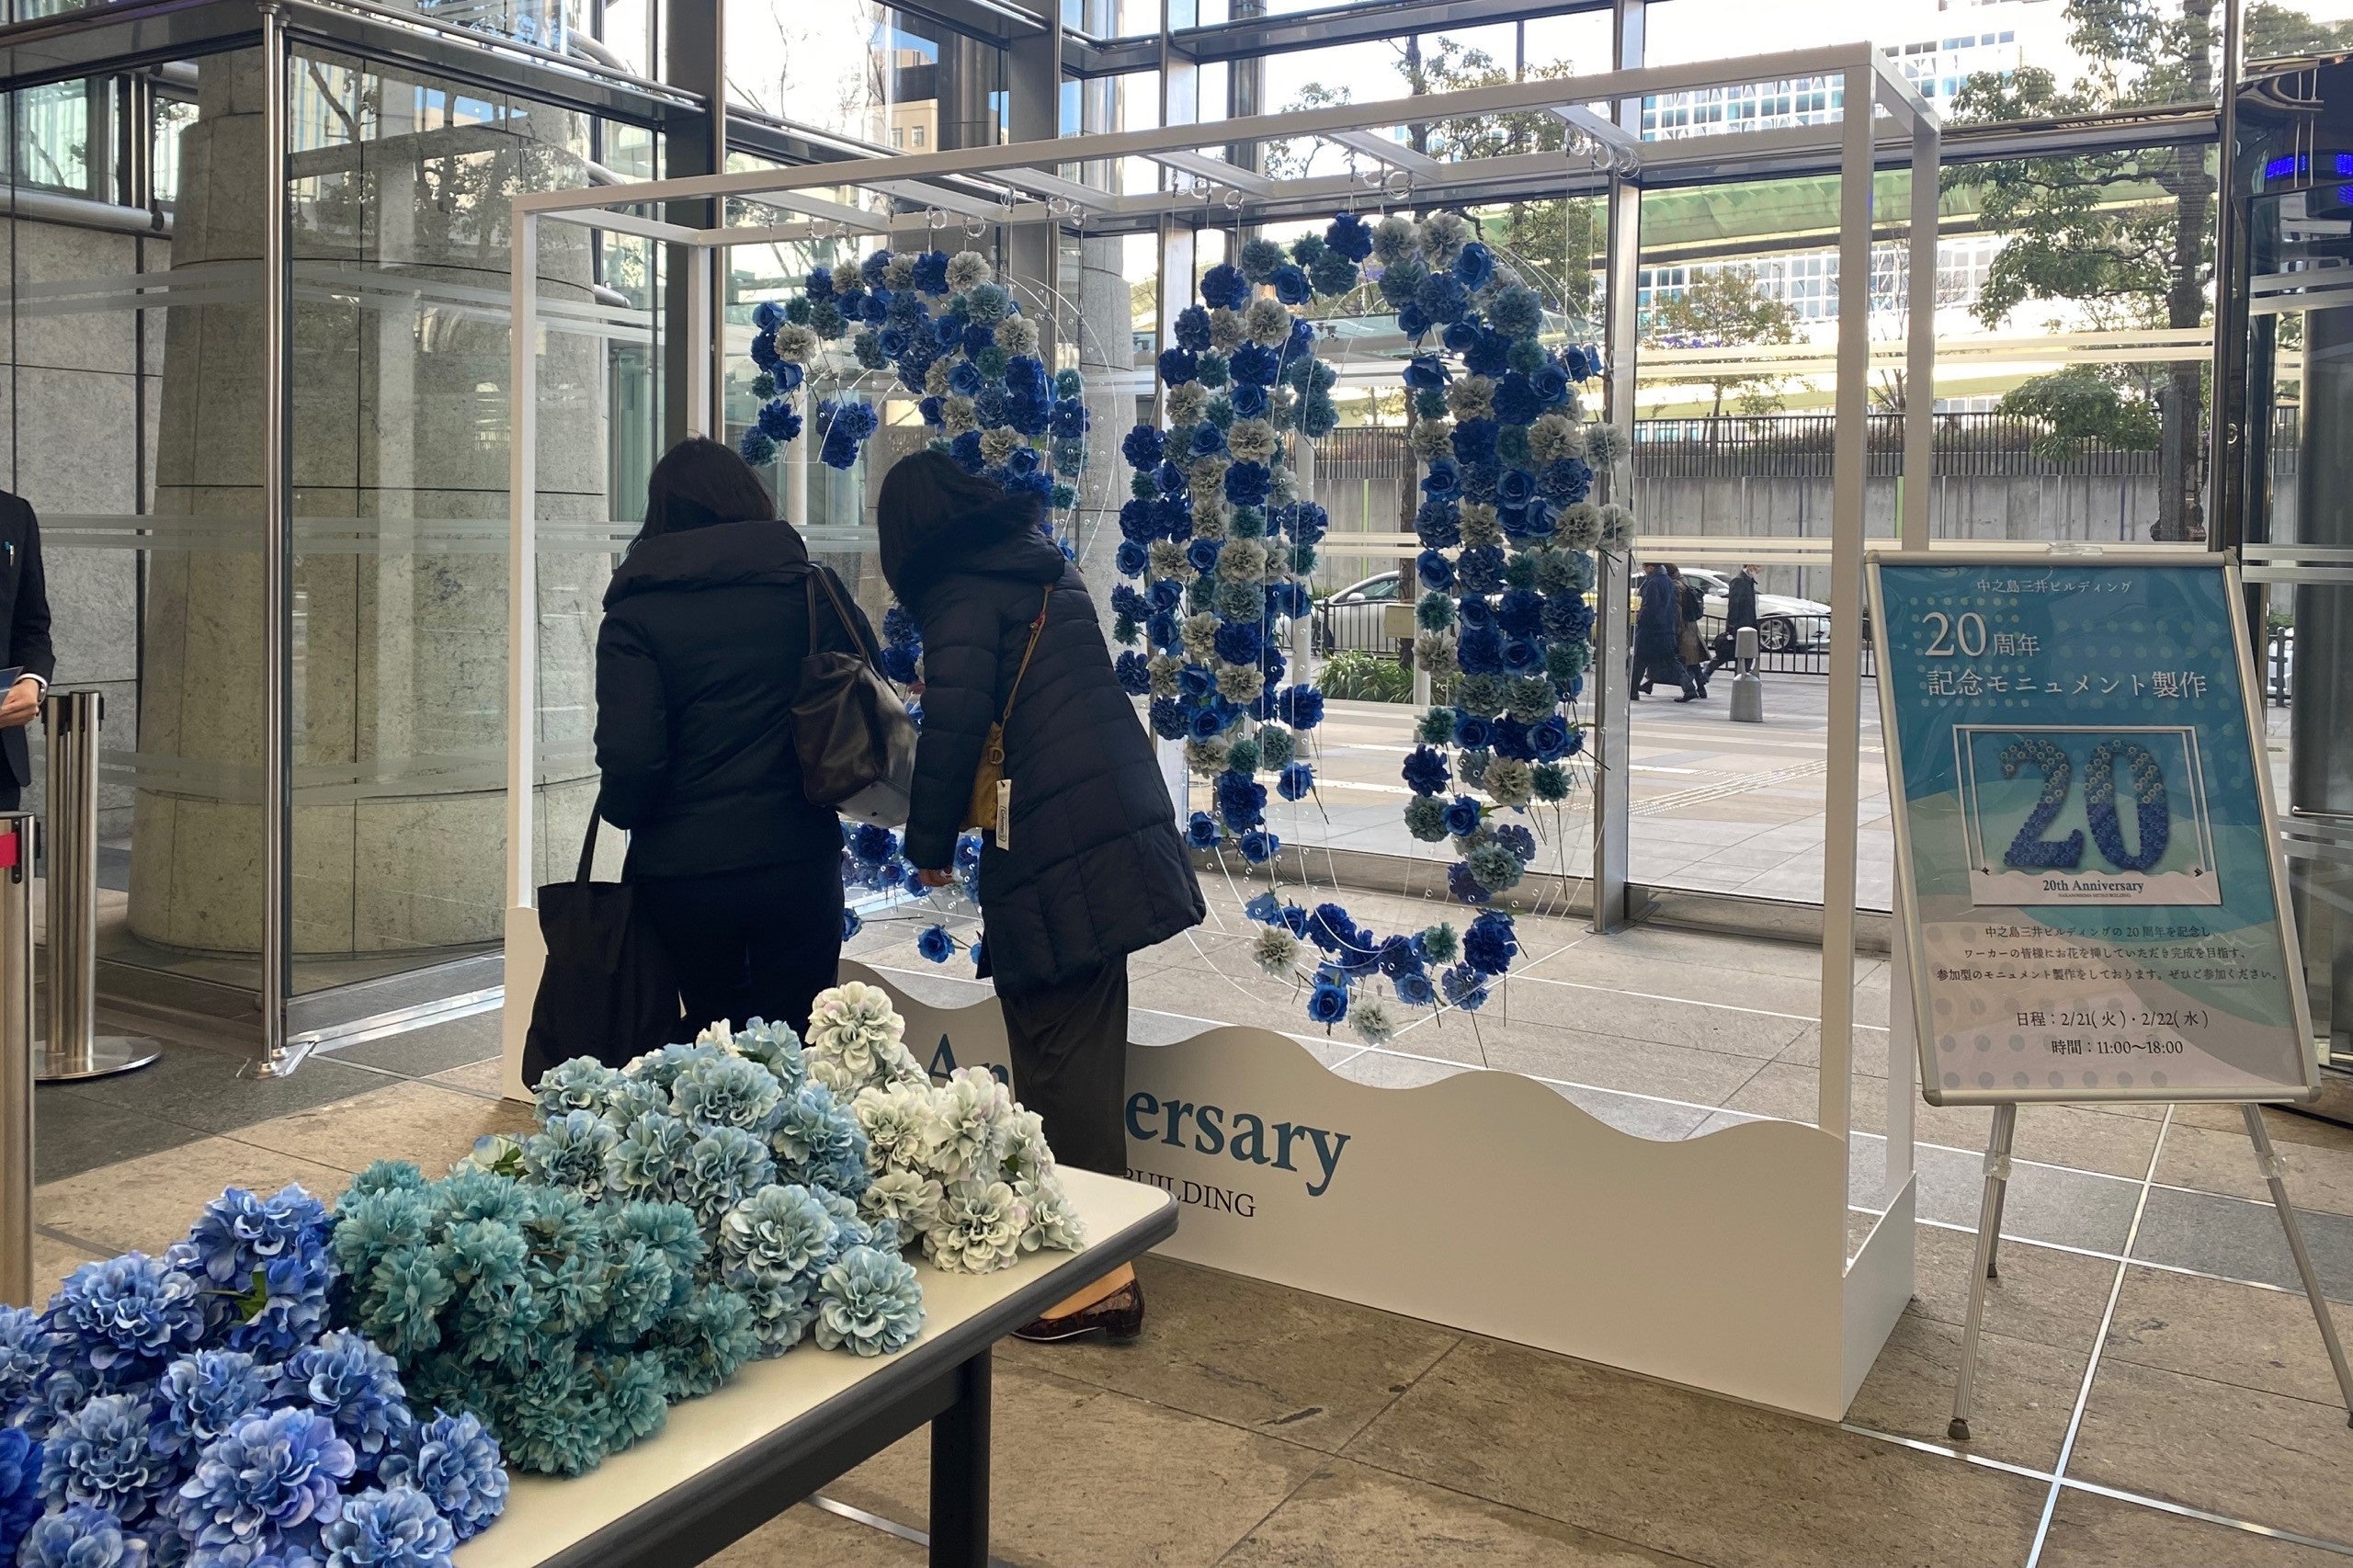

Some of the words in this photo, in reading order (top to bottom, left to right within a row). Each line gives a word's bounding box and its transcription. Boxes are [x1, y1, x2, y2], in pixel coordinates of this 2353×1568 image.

[1976, 578, 2132, 594] 中之島三井ビルディング
[1921, 611, 2040, 657] 20周年
[1927, 668, 2208, 699] 記念モニュメント製作
[2042, 880, 2069, 892] 20th
[2072, 880, 2144, 893] Anniversary
